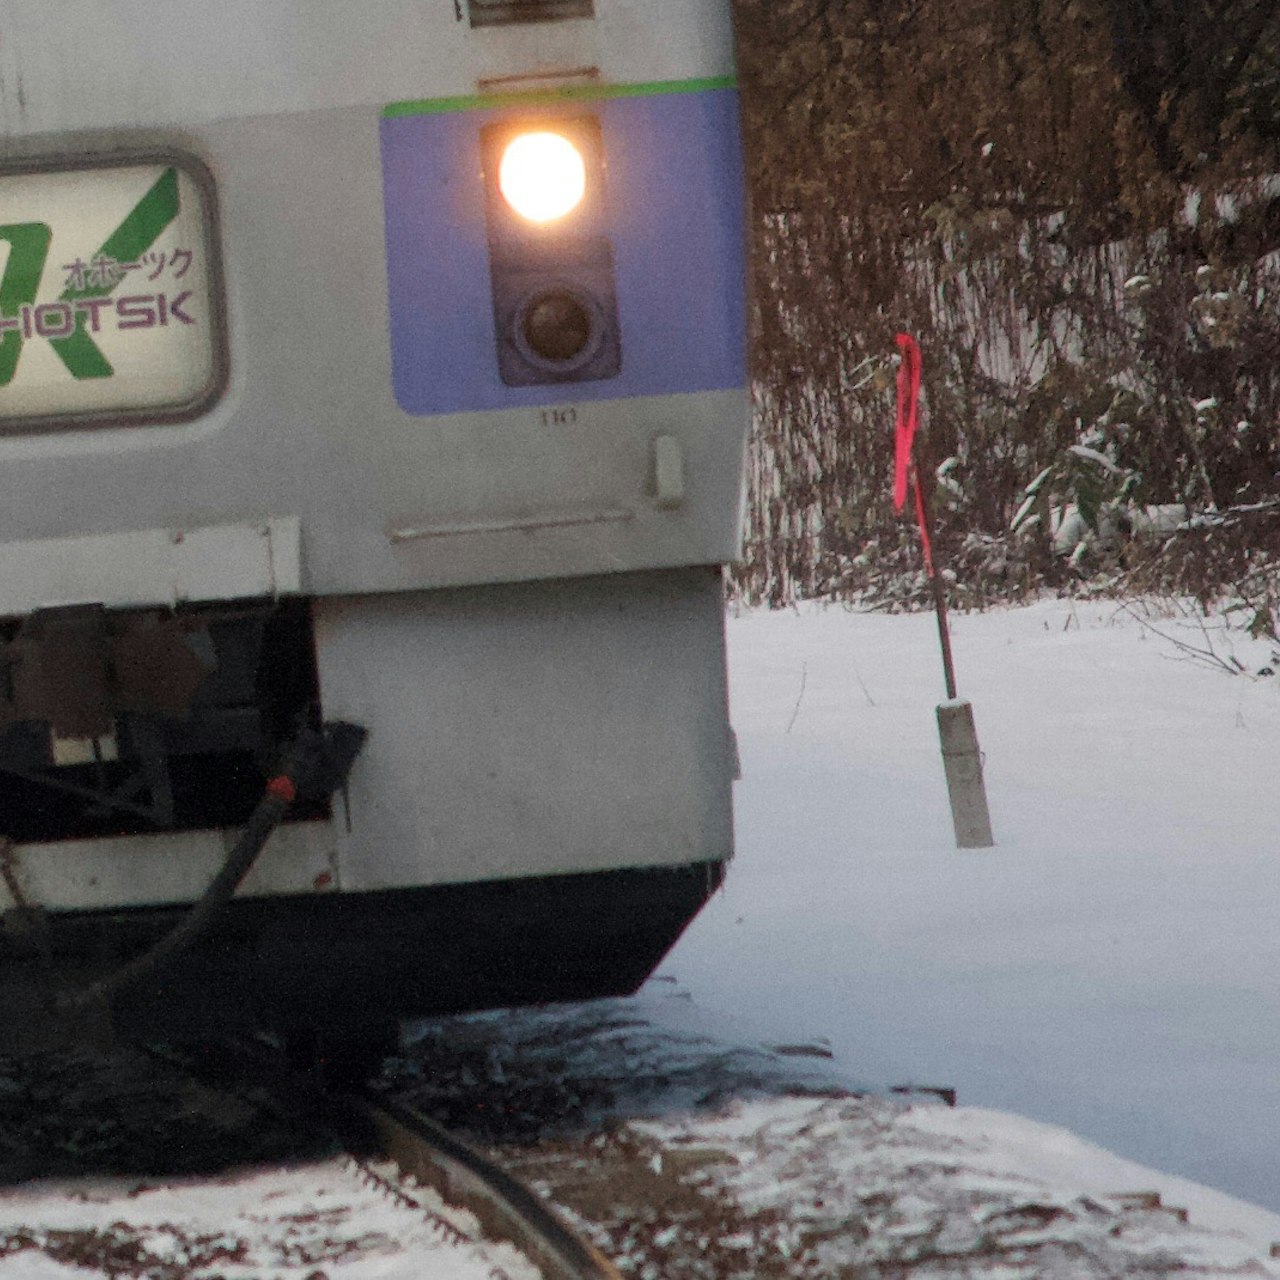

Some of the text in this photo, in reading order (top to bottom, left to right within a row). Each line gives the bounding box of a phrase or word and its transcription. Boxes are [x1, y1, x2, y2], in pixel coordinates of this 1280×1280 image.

[62, 249, 193, 291] オホーツク
